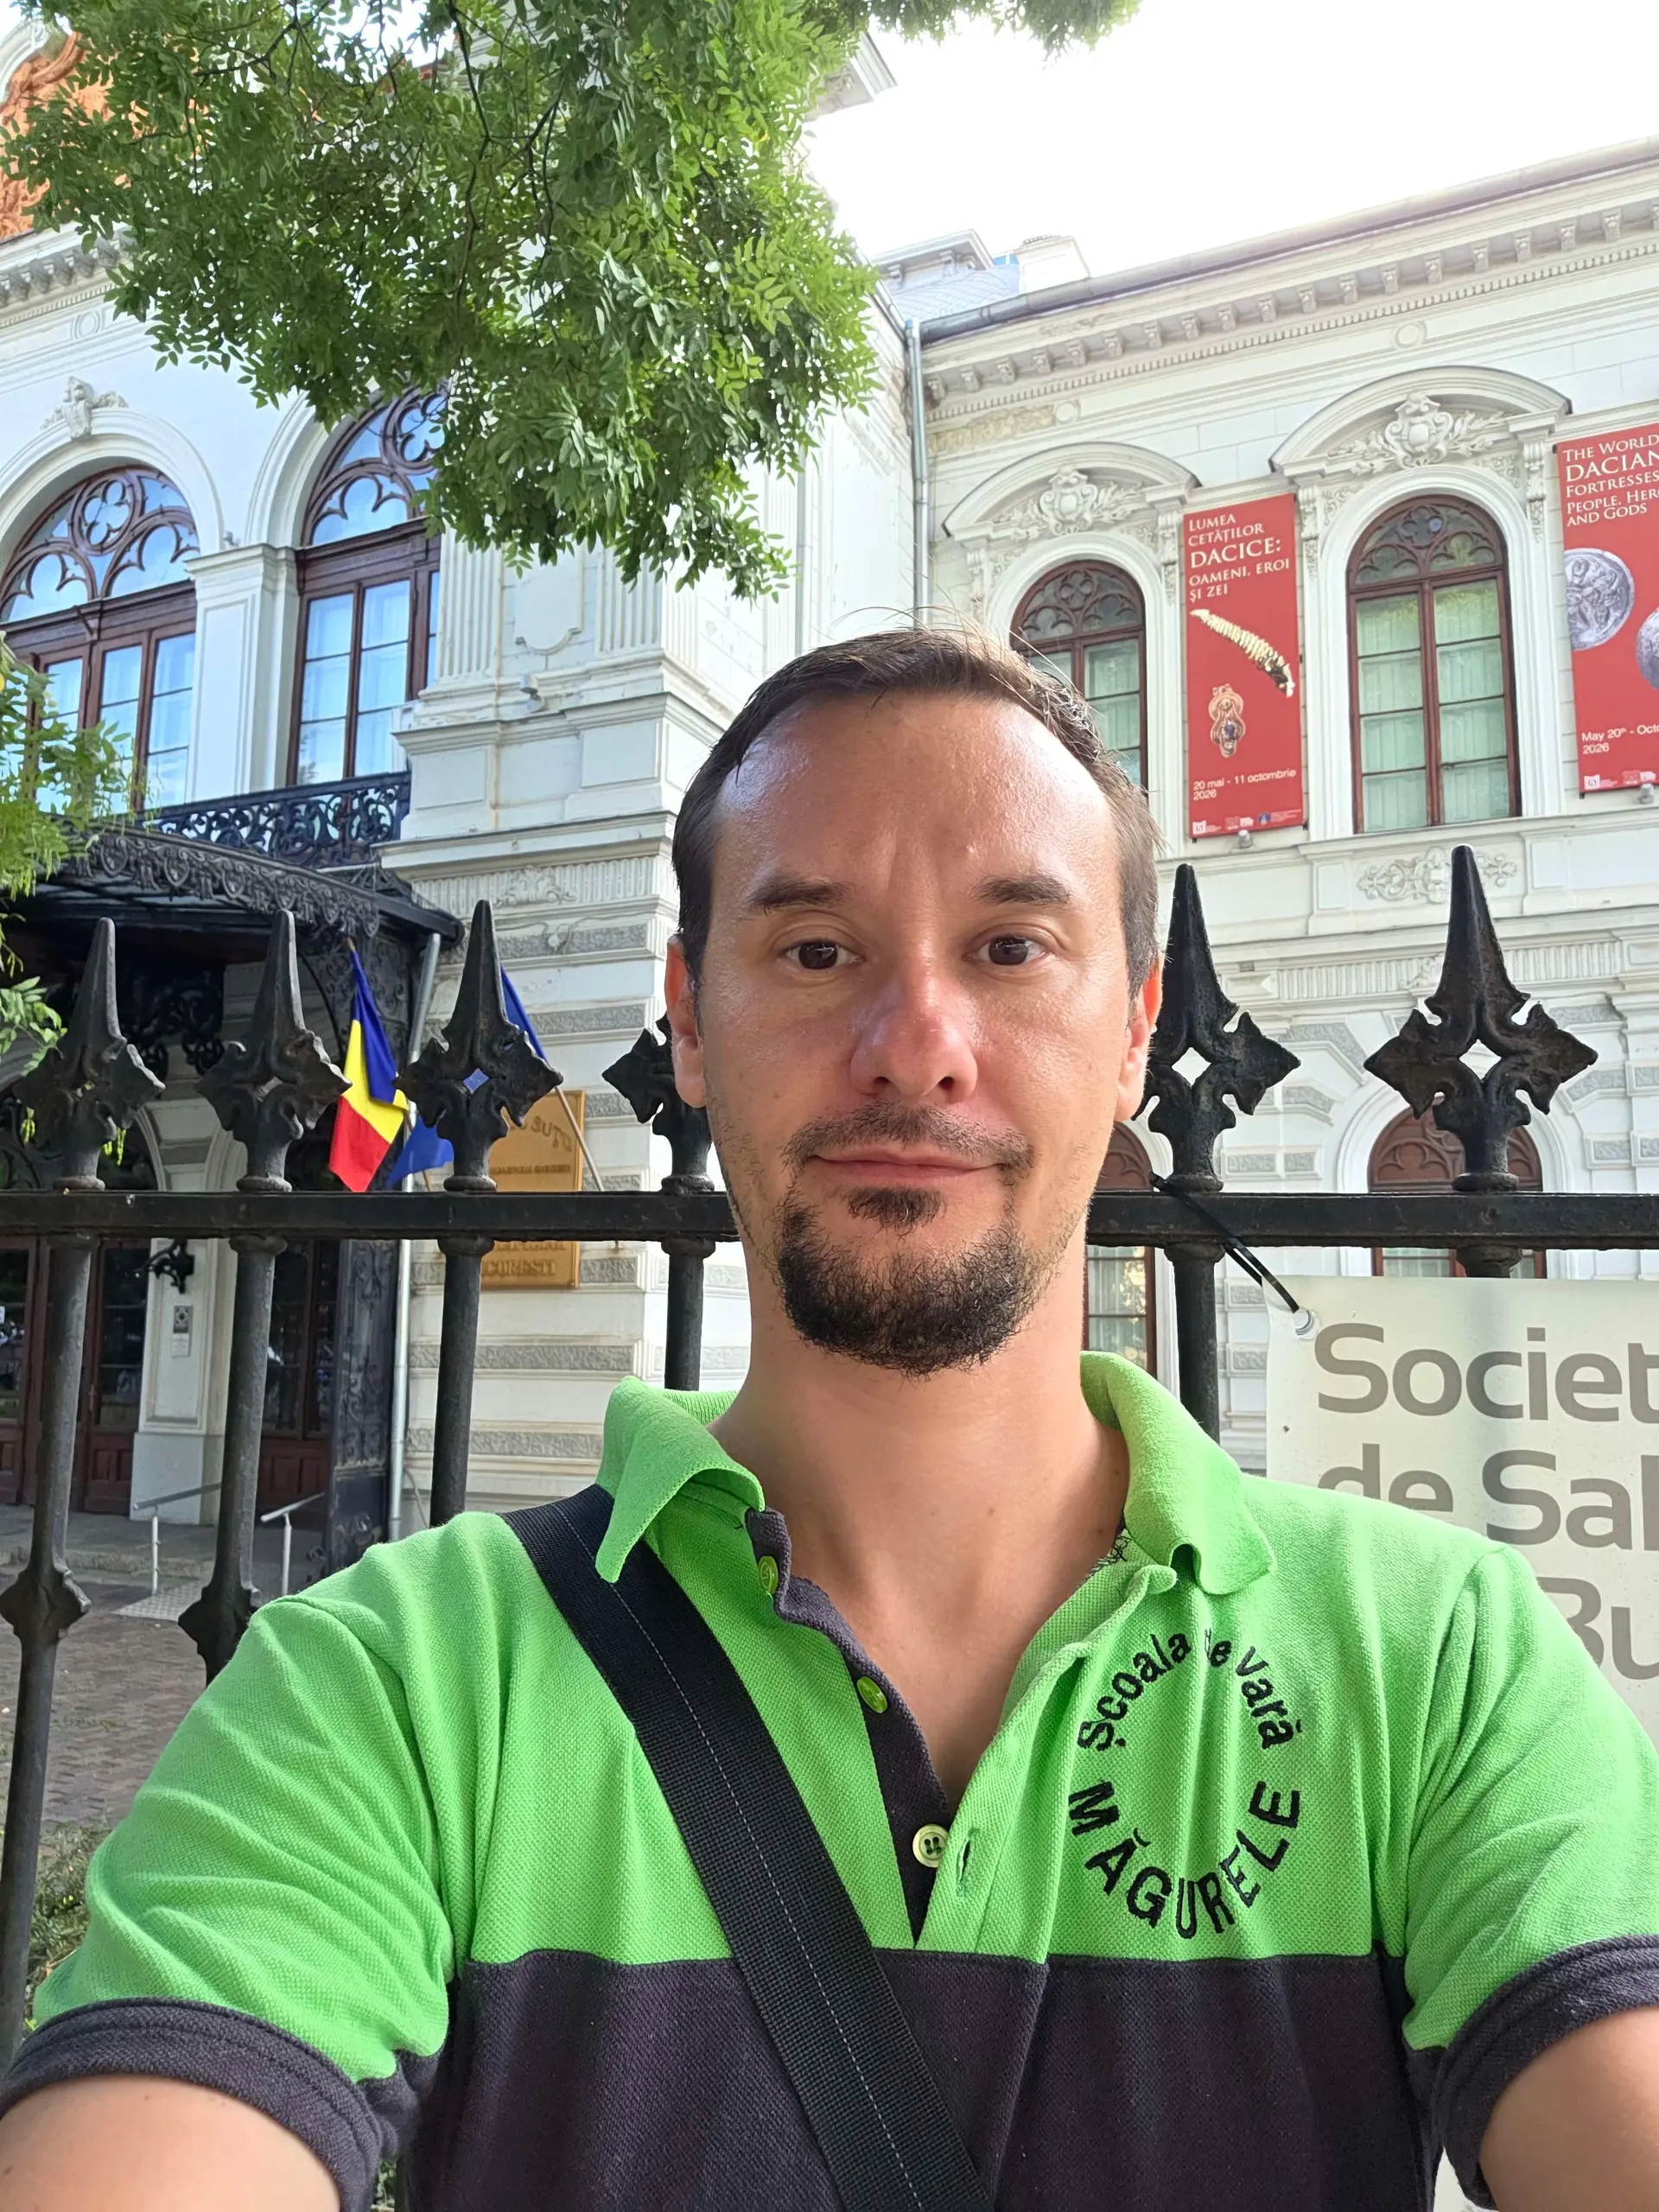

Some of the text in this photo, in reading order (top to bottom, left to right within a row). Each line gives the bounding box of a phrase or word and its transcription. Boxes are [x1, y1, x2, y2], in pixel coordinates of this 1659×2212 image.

[1562, 435, 1659, 462] THE WORLD
[1567, 470, 1659, 498] FORTRESSES
[1626, 488, 1659, 504] HER
[1189, 513, 1236, 532] LUMEA
[1567, 502, 1648, 527] AND GODS
[1191, 537, 1281, 569] DACICE:
[1256, 558, 1290, 575] EROI
[1206, 584, 1228, 598] ZEI
[1581, 731, 1605, 741] May
[1582, 742, 1610, 754] 2026
[1193, 780, 1205, 791] 20
[1207, 778, 1224, 788] mai
[1234, 775, 1245, 785] 11
[1247, 768, 1297, 783] octombrie
[1193, 789, 1217, 801] 2026
[1314, 1323, 1659, 1424] Societ
[1068, 1780, 1300, 1939] MĂGURELE
